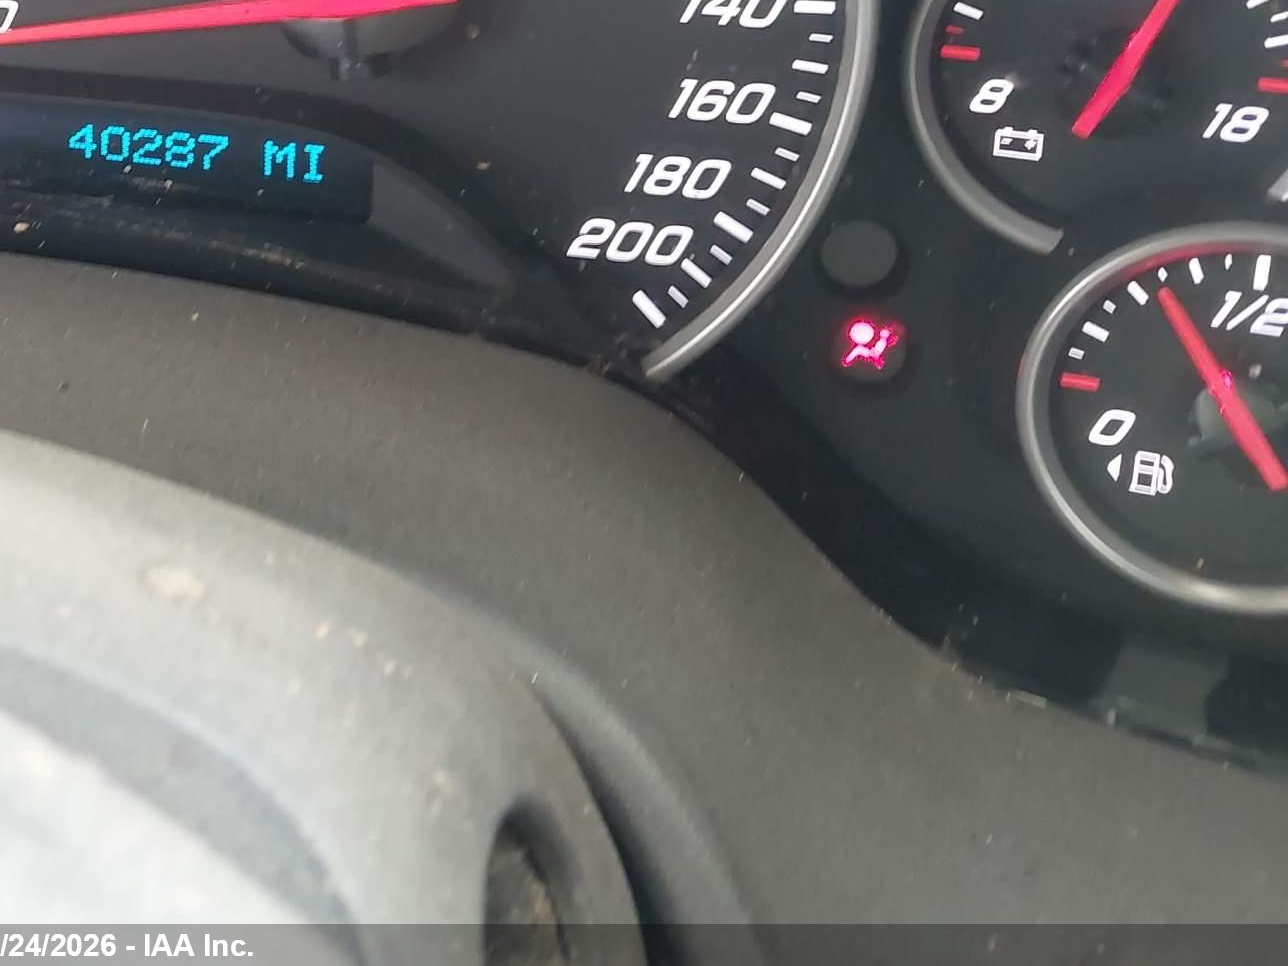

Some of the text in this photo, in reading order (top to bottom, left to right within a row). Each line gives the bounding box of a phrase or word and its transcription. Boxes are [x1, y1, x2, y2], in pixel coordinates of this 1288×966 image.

[668, 78, 776, 127] 160
[969, 78, 1014, 114] 8
[1202, 103, 1270, 143] 18
[66, 121, 230, 172] 40287
[261, 138, 327, 186] MI
[624, 153, 732, 199] 180
[566, 218, 694, 268] 200
[1210, 290, 1288, 338] 1/2
[1088, 409, 1137, 446] 0
